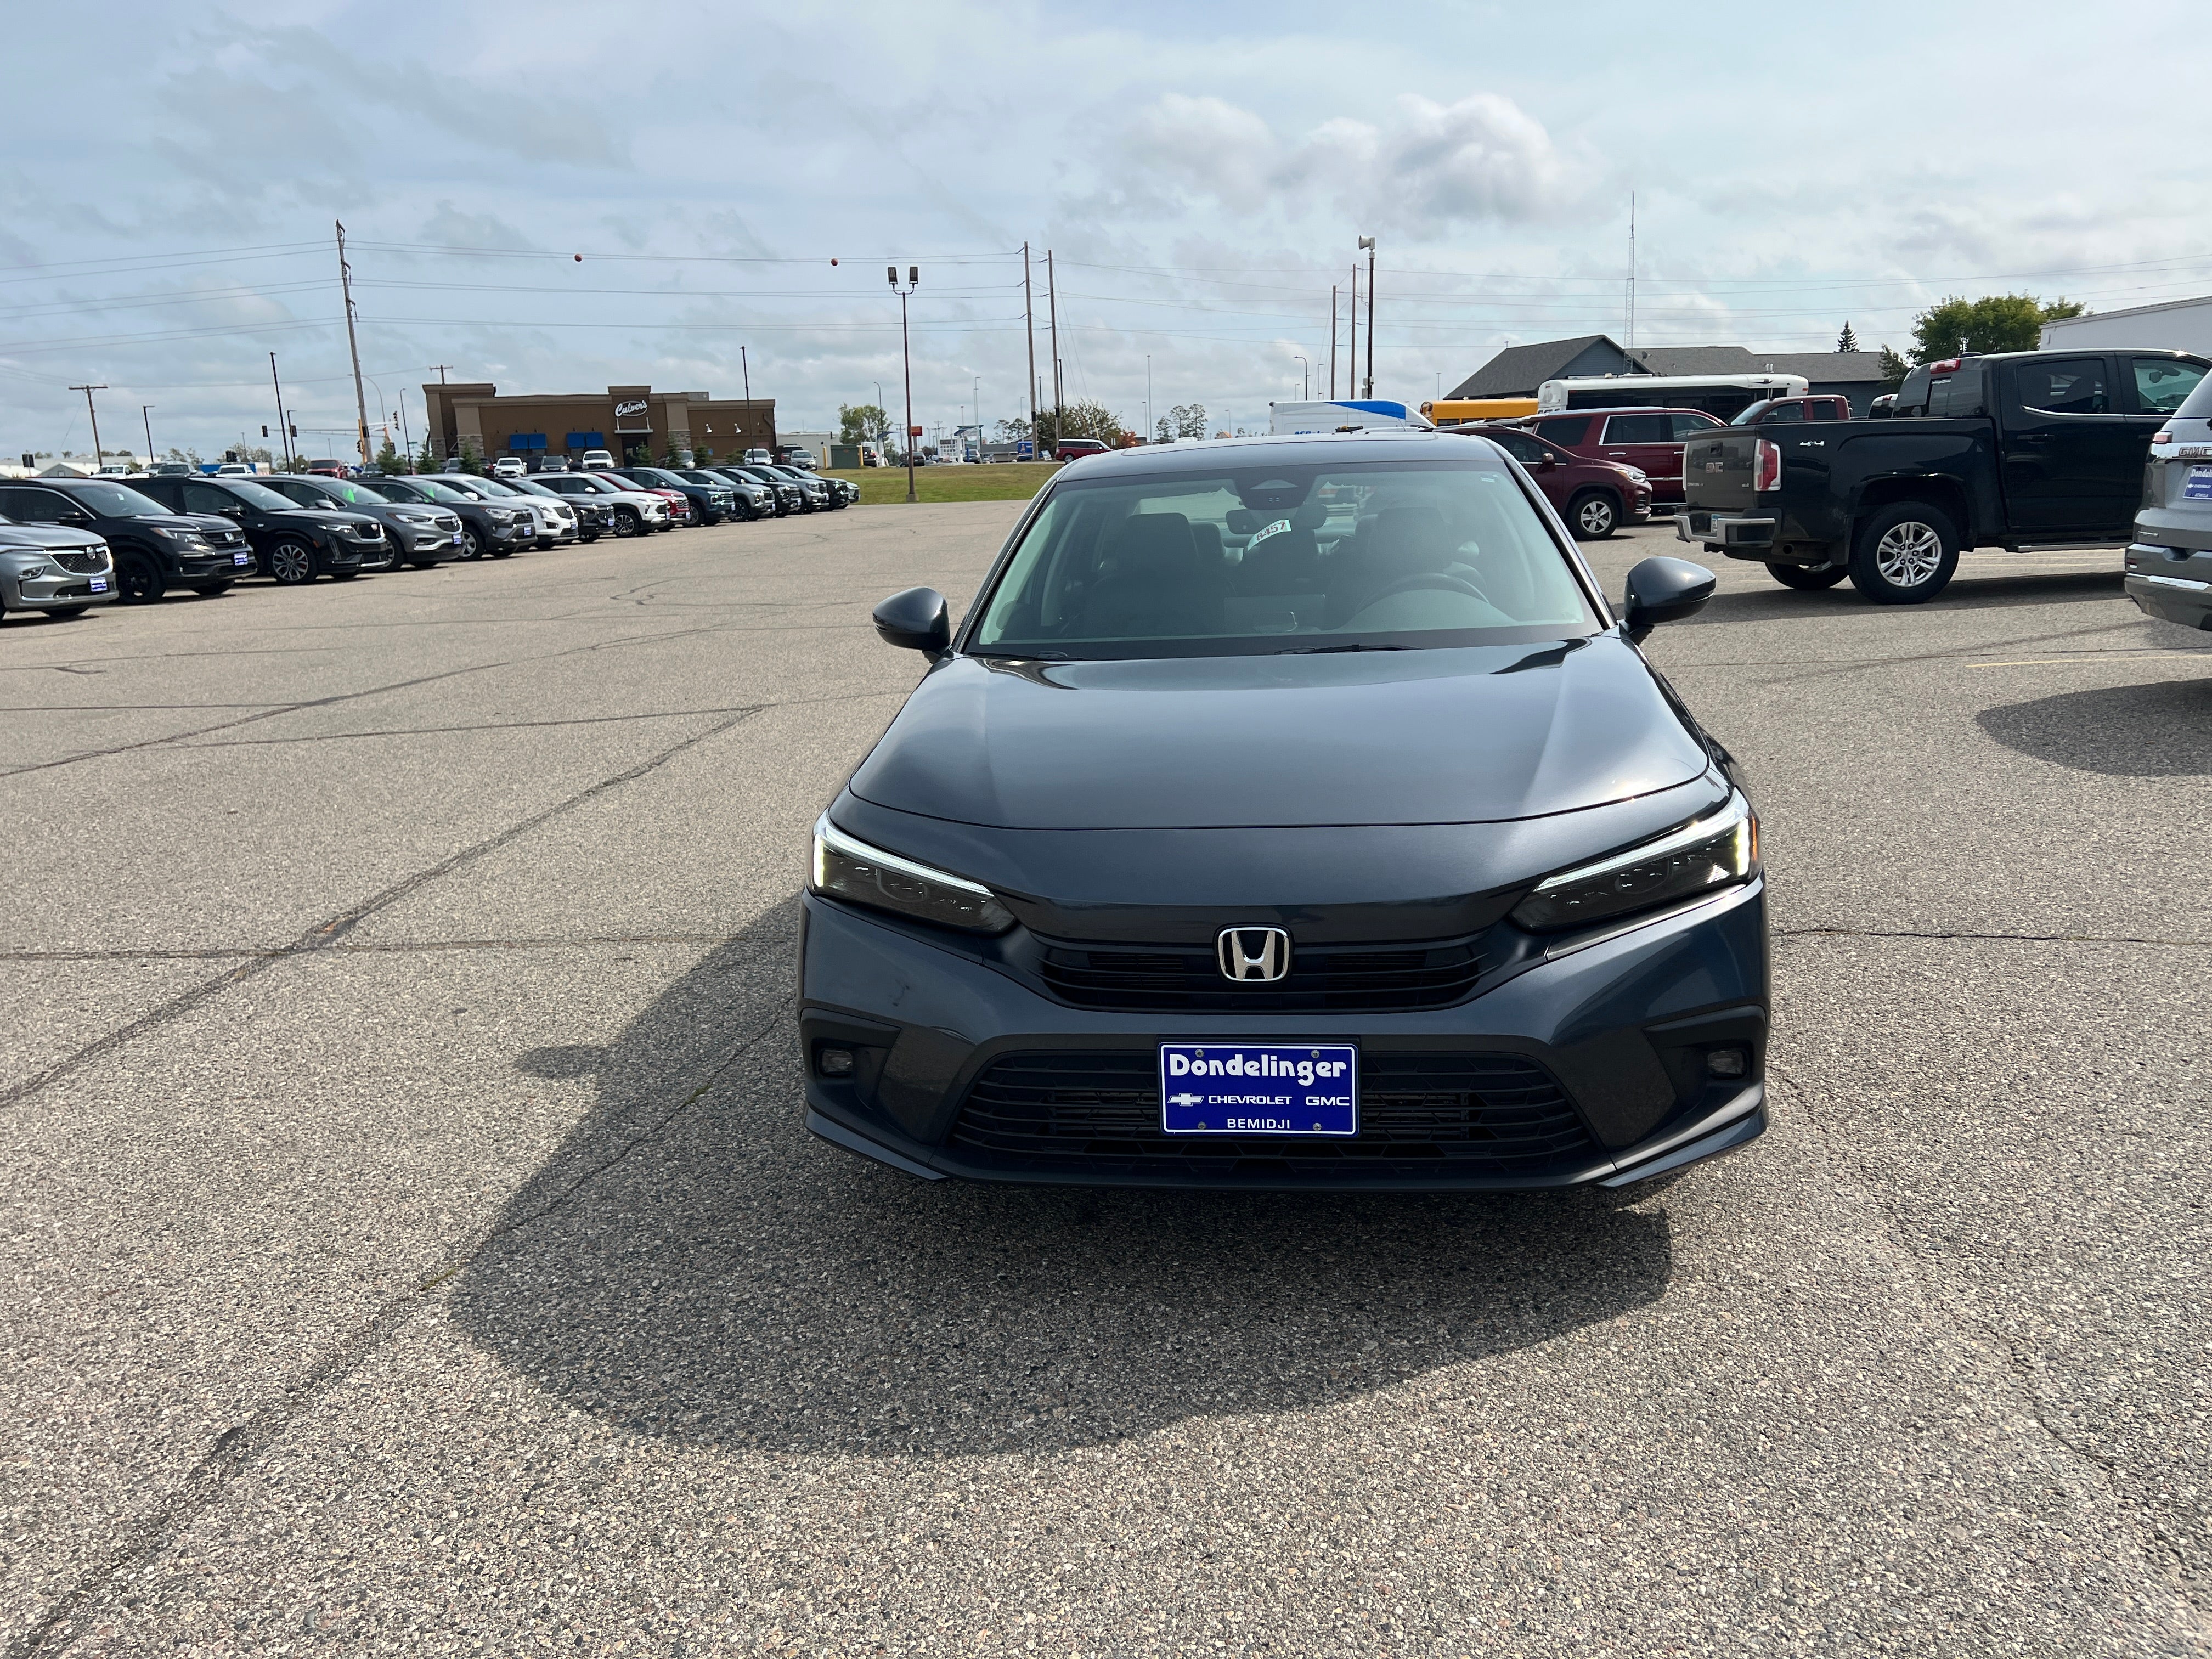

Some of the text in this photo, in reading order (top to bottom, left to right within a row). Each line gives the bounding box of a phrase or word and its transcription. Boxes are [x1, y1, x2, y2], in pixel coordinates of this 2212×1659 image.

[615, 400, 647, 417] Culver's
[2179, 447, 2212, 456] GMC
[1256, 522, 1286, 541] 8457
[1169, 1053, 1346, 1086] Dondelinger
[1208, 1095, 1350, 1106] CHEVROLET GMC
[1227, 1118, 1290, 1129] BEMIDJI
